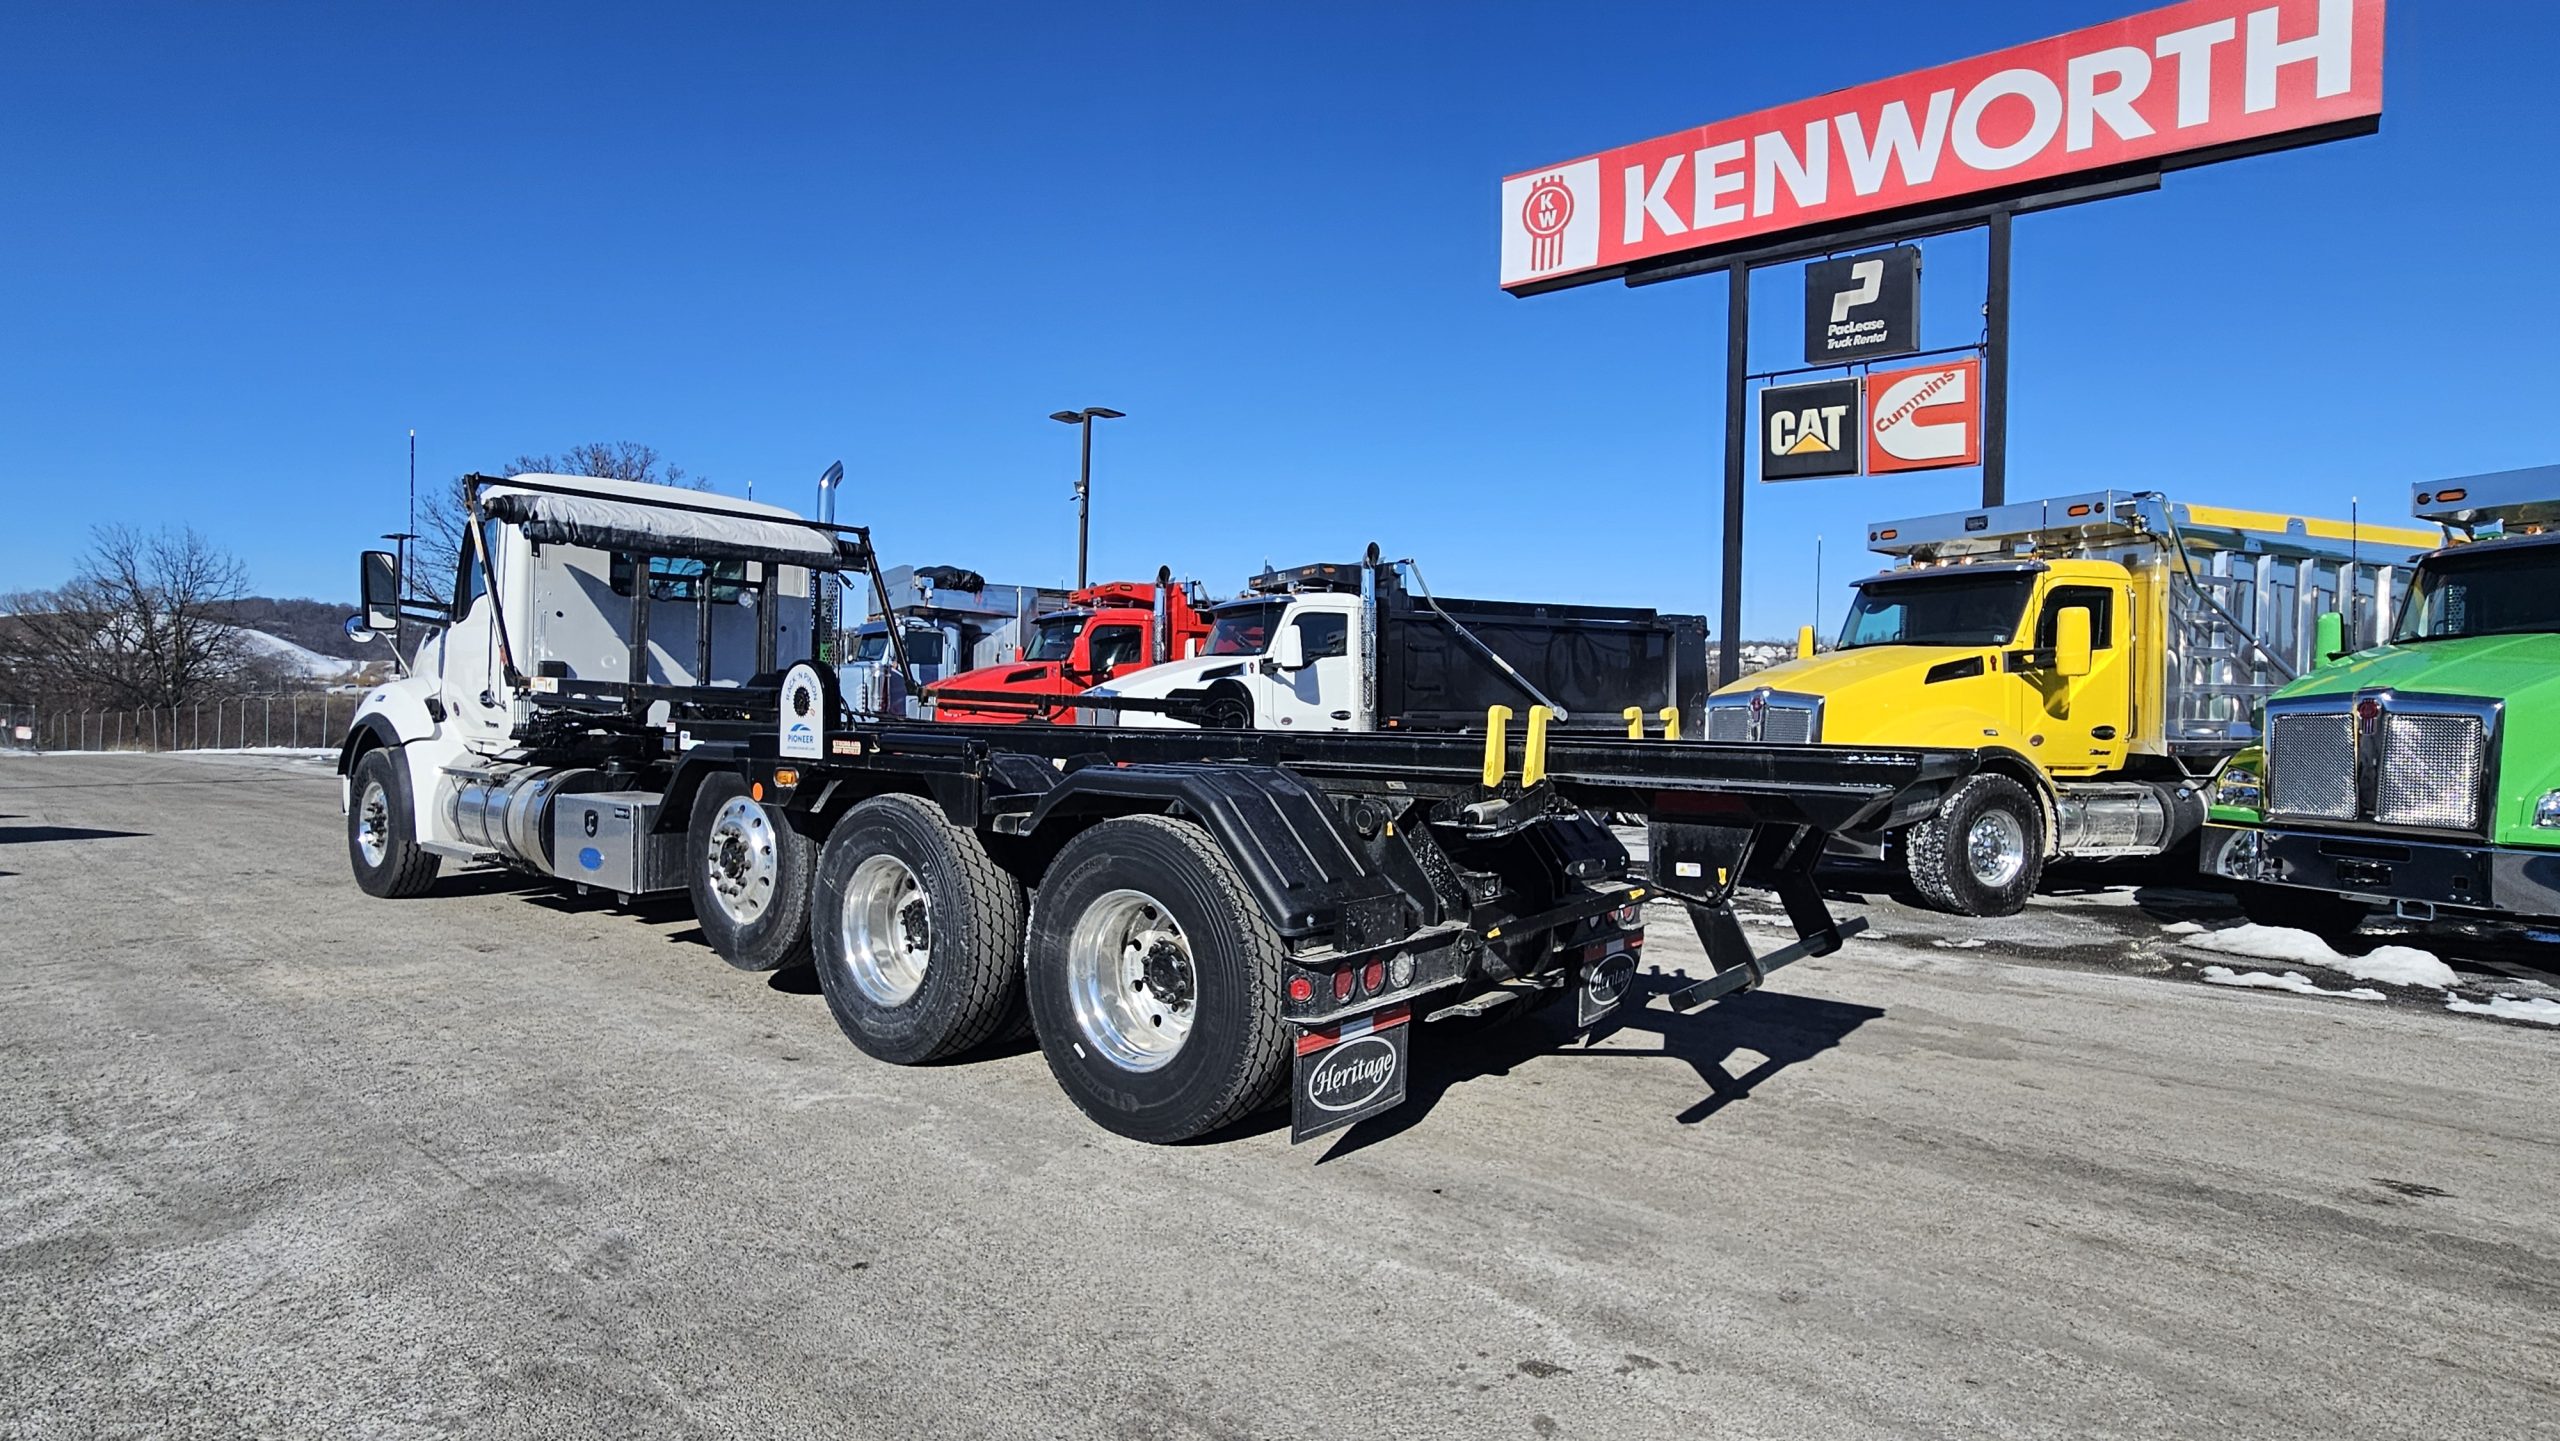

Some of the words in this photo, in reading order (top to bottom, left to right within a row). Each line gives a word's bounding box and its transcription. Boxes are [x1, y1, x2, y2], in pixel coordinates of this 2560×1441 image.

[1623, 0, 2353, 246] KENWORTH
[1827, 319, 1885, 336] PacLease
[1827, 336, 1853, 349] Truck
[1853, 330, 1888, 346] Rental
[1875, 371, 1955, 432] Cummins
[1770, 405, 1846, 456] CAT
[787, 734, 814, 744] PIONEER
[1313, 1053, 1393, 1096] Heritage
